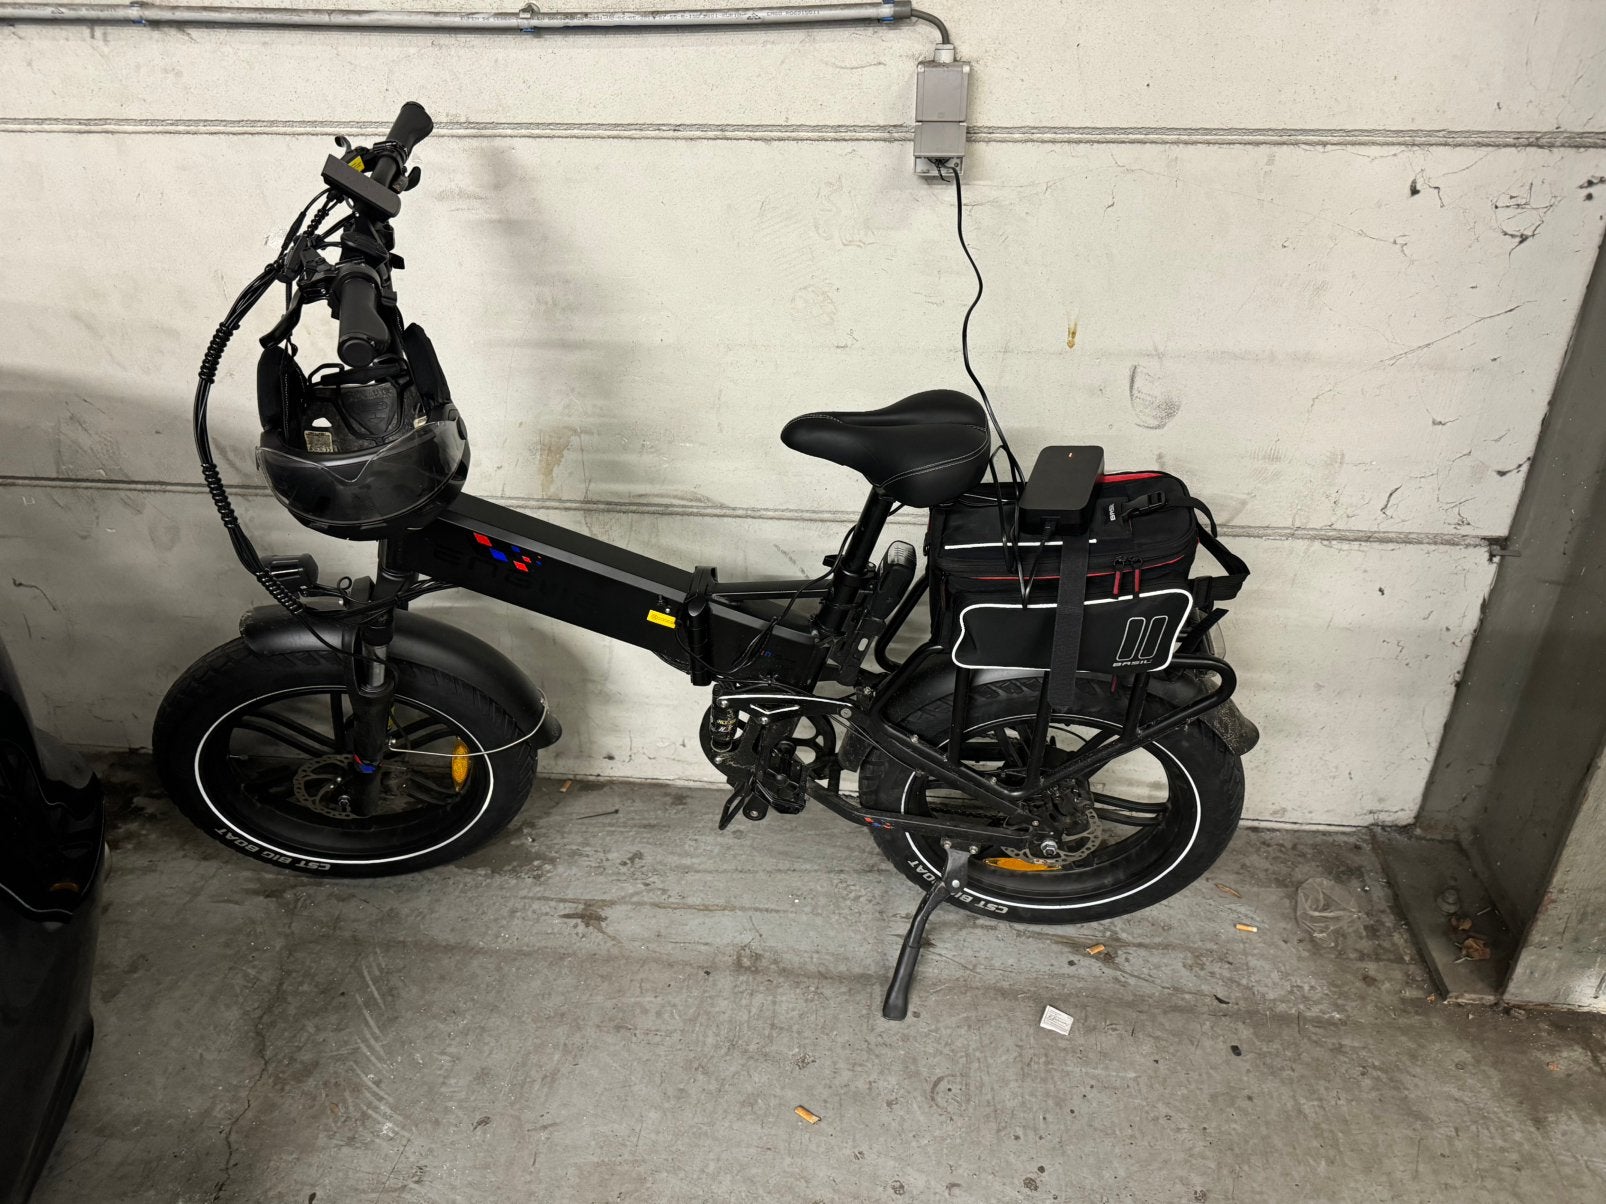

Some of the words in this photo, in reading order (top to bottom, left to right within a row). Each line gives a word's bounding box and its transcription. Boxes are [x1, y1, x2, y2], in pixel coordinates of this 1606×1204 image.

[213, 827, 260, 853] BOAT
[260, 850, 293, 864] BIG
[295, 860, 331, 871] CST
[907, 860, 937, 884] OAT
[950, 891, 974, 903] BI
[974, 900, 1009, 914] CST
